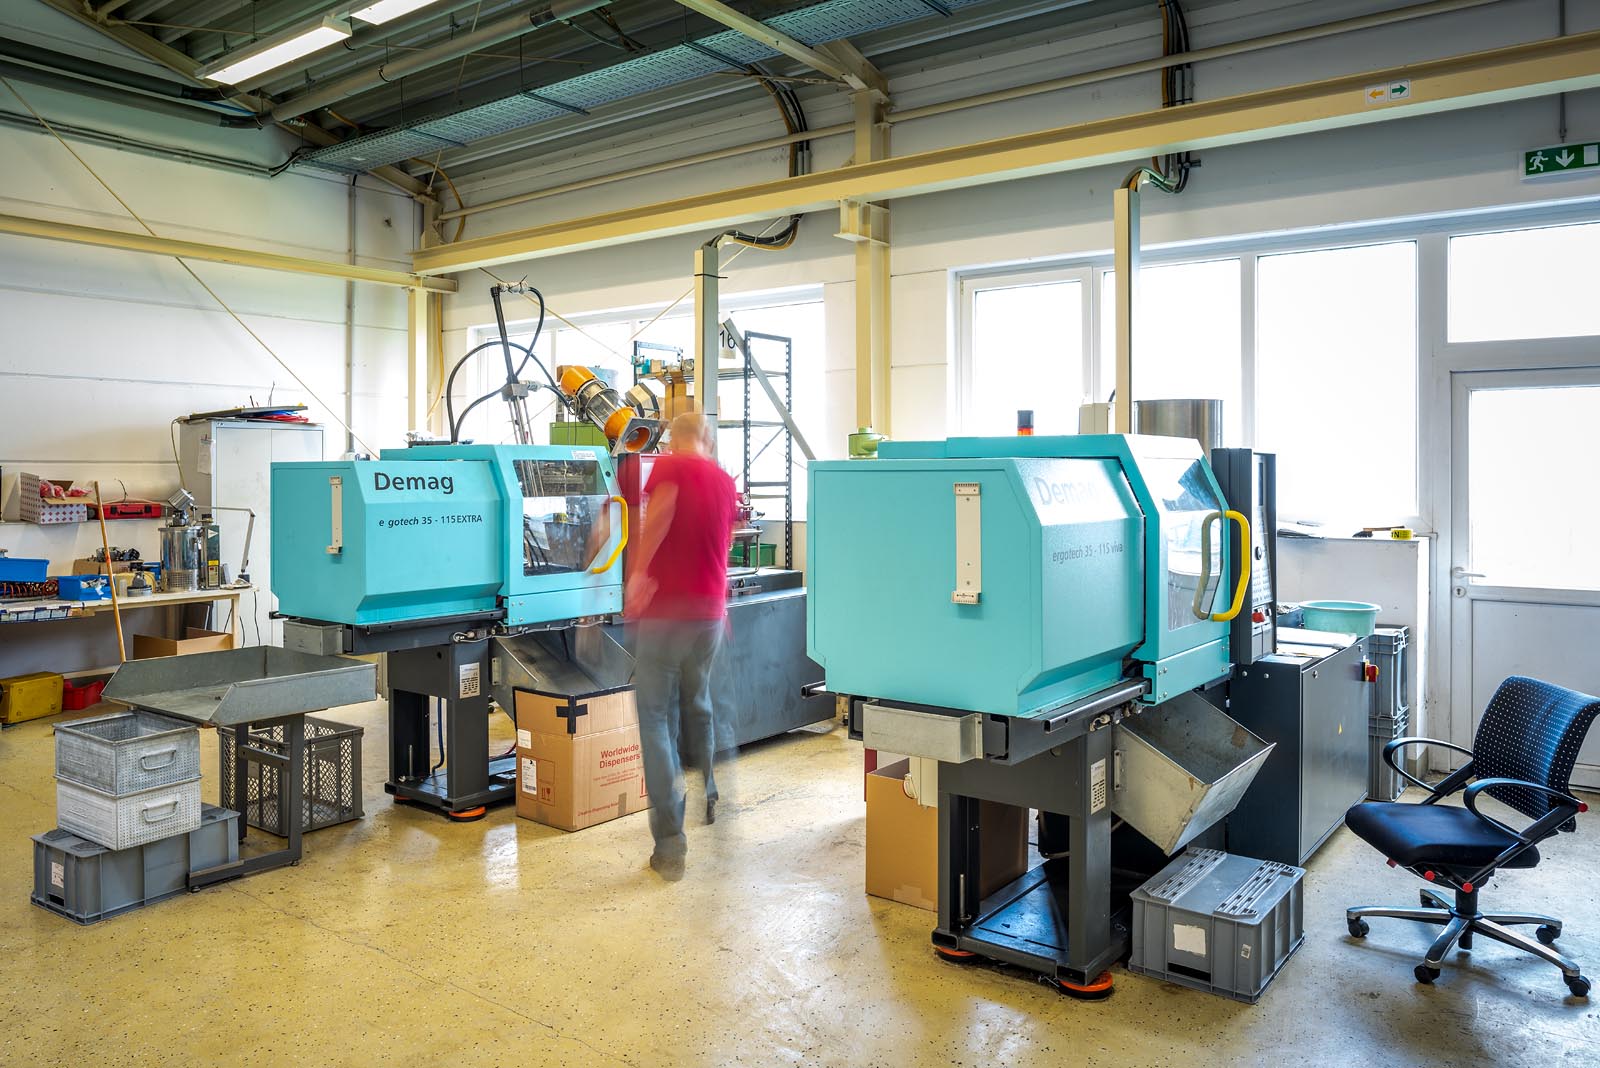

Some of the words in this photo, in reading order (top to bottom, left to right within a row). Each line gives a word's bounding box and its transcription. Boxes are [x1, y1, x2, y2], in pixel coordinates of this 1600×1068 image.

[719, 329, 737, 349] 16
[374, 472, 454, 494] Demag
[421, 516, 433, 525] 35
[1052, 545, 1083, 565] ergotech
[1085, 544, 1093, 557] 35
[1099, 542, 1110, 555] 115
[600, 744, 640, 759] Worldwide
[599, 753, 641, 769] Dispensers
